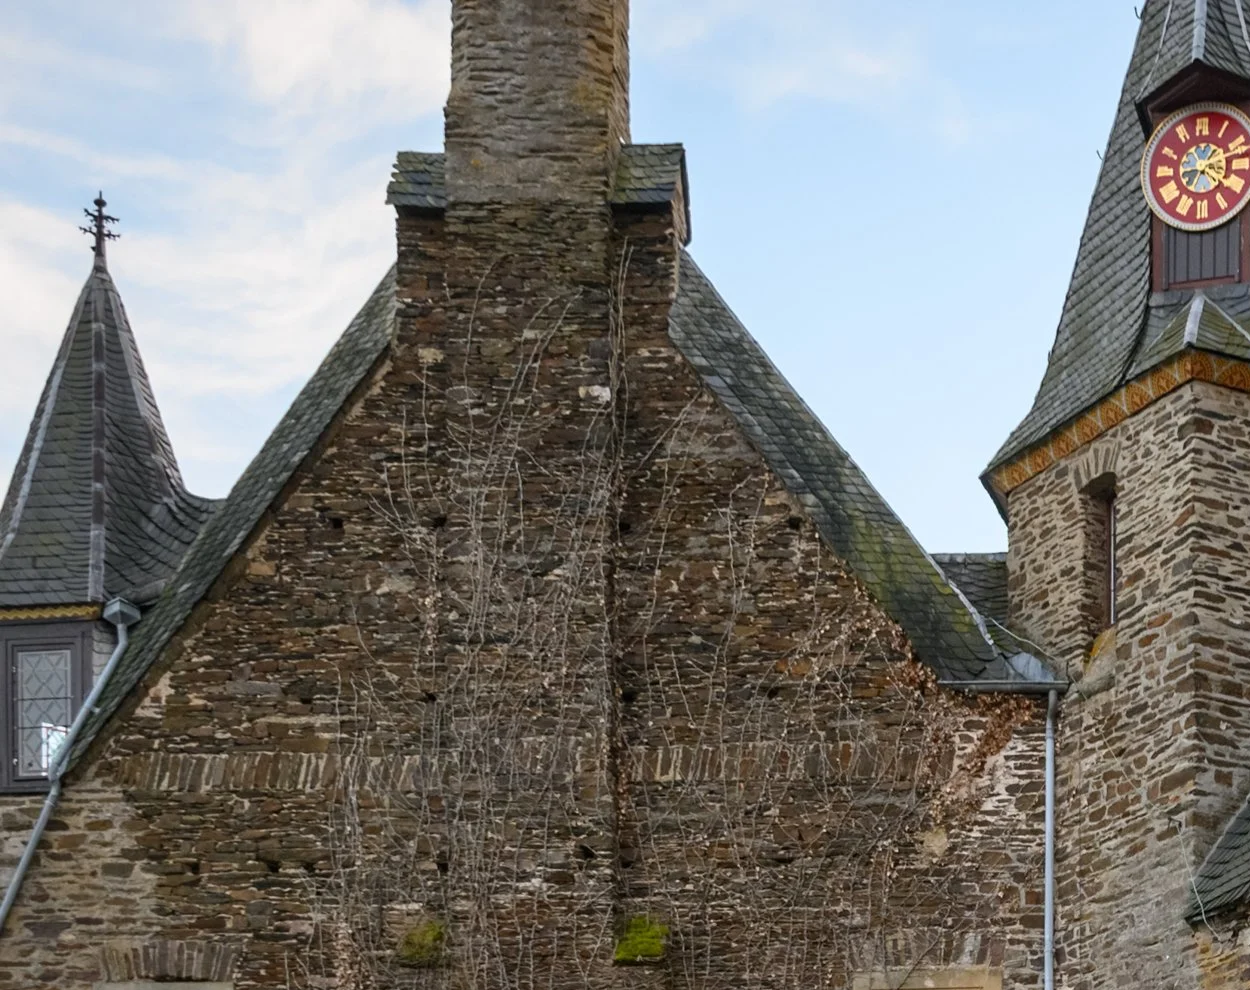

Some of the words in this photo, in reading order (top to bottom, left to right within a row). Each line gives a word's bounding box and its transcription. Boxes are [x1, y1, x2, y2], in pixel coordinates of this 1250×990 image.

[1218, 120, 1229, 138] I
[1232, 157, 1250, 170] III
[1215, 192, 1228, 210] V
